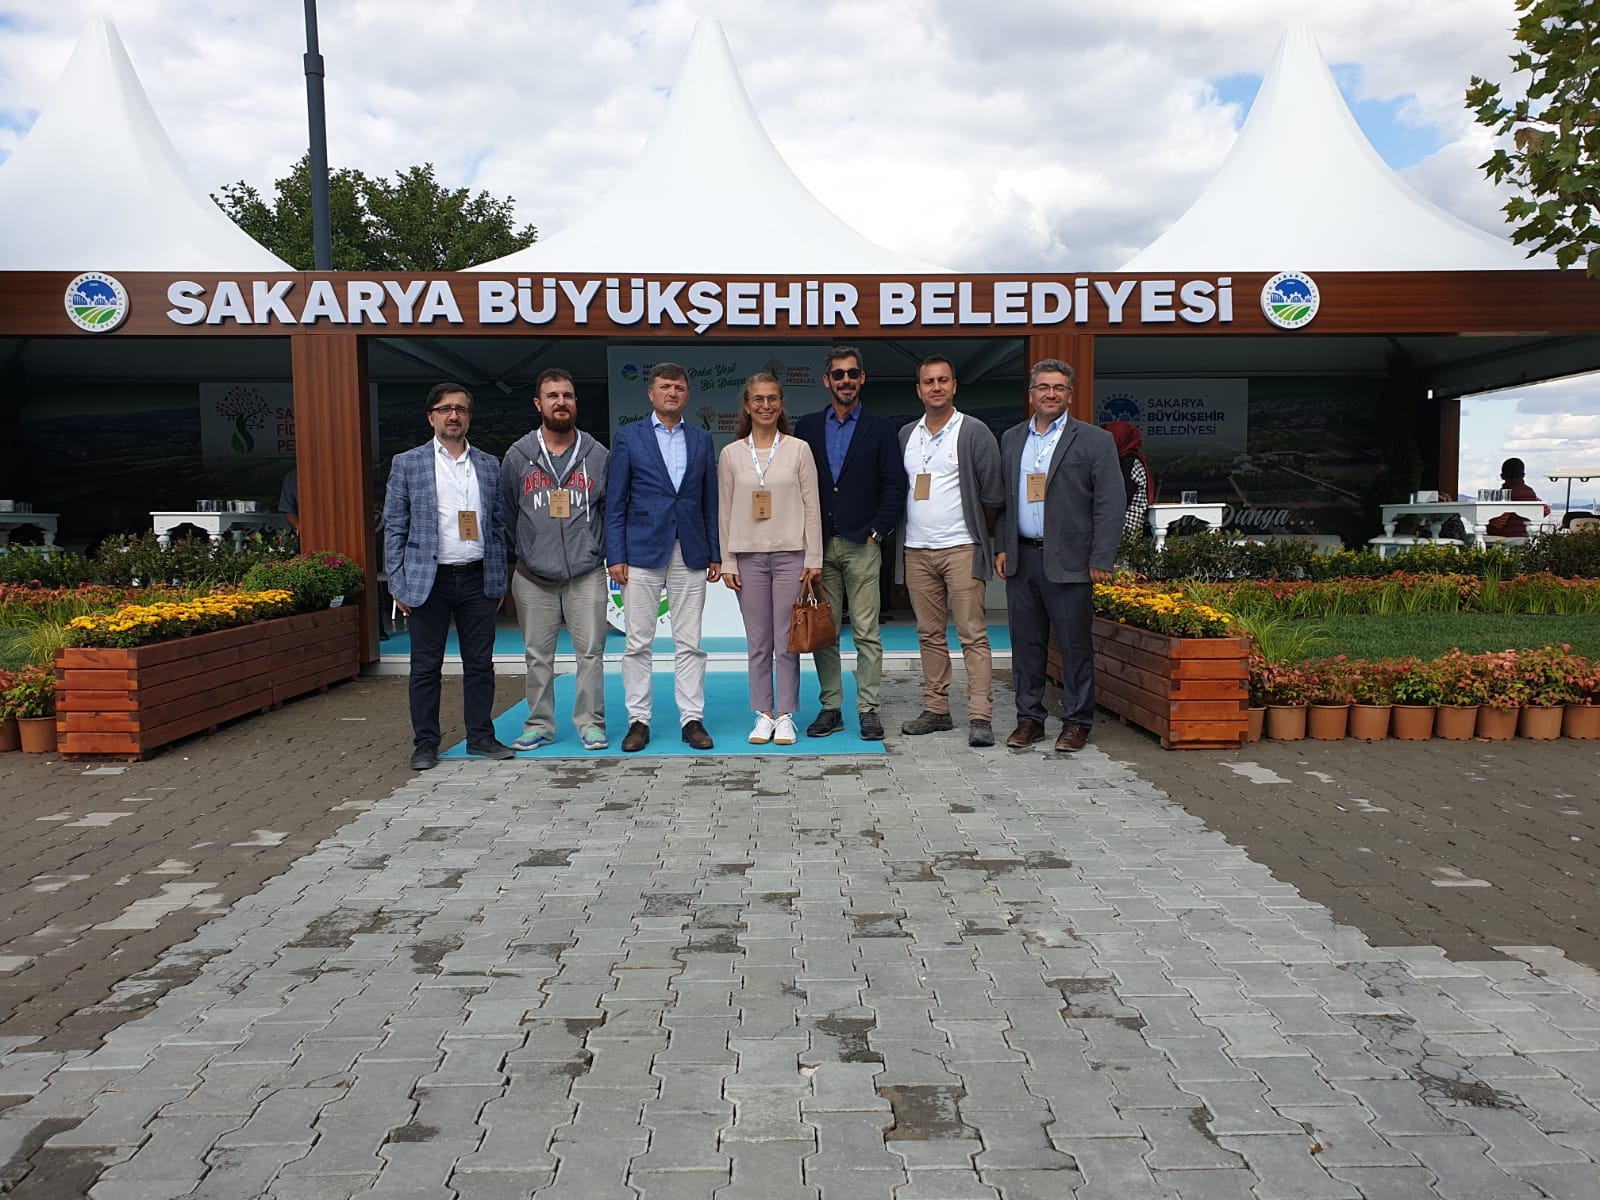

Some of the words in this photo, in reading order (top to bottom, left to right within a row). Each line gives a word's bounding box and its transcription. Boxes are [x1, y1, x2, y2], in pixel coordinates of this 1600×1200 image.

[166, 280, 465, 325] SAKARYA
[478, 277, 860, 334] BÜYÜKŞEHİR
[879, 276, 1234, 326] BELEDİYESİ
[1147, 398, 1205, 408] SAKARYA
[1147, 410, 1225, 423] BÜYÜKŞEHİR
[1147, 424, 1216, 436] BELEDİYESİ
